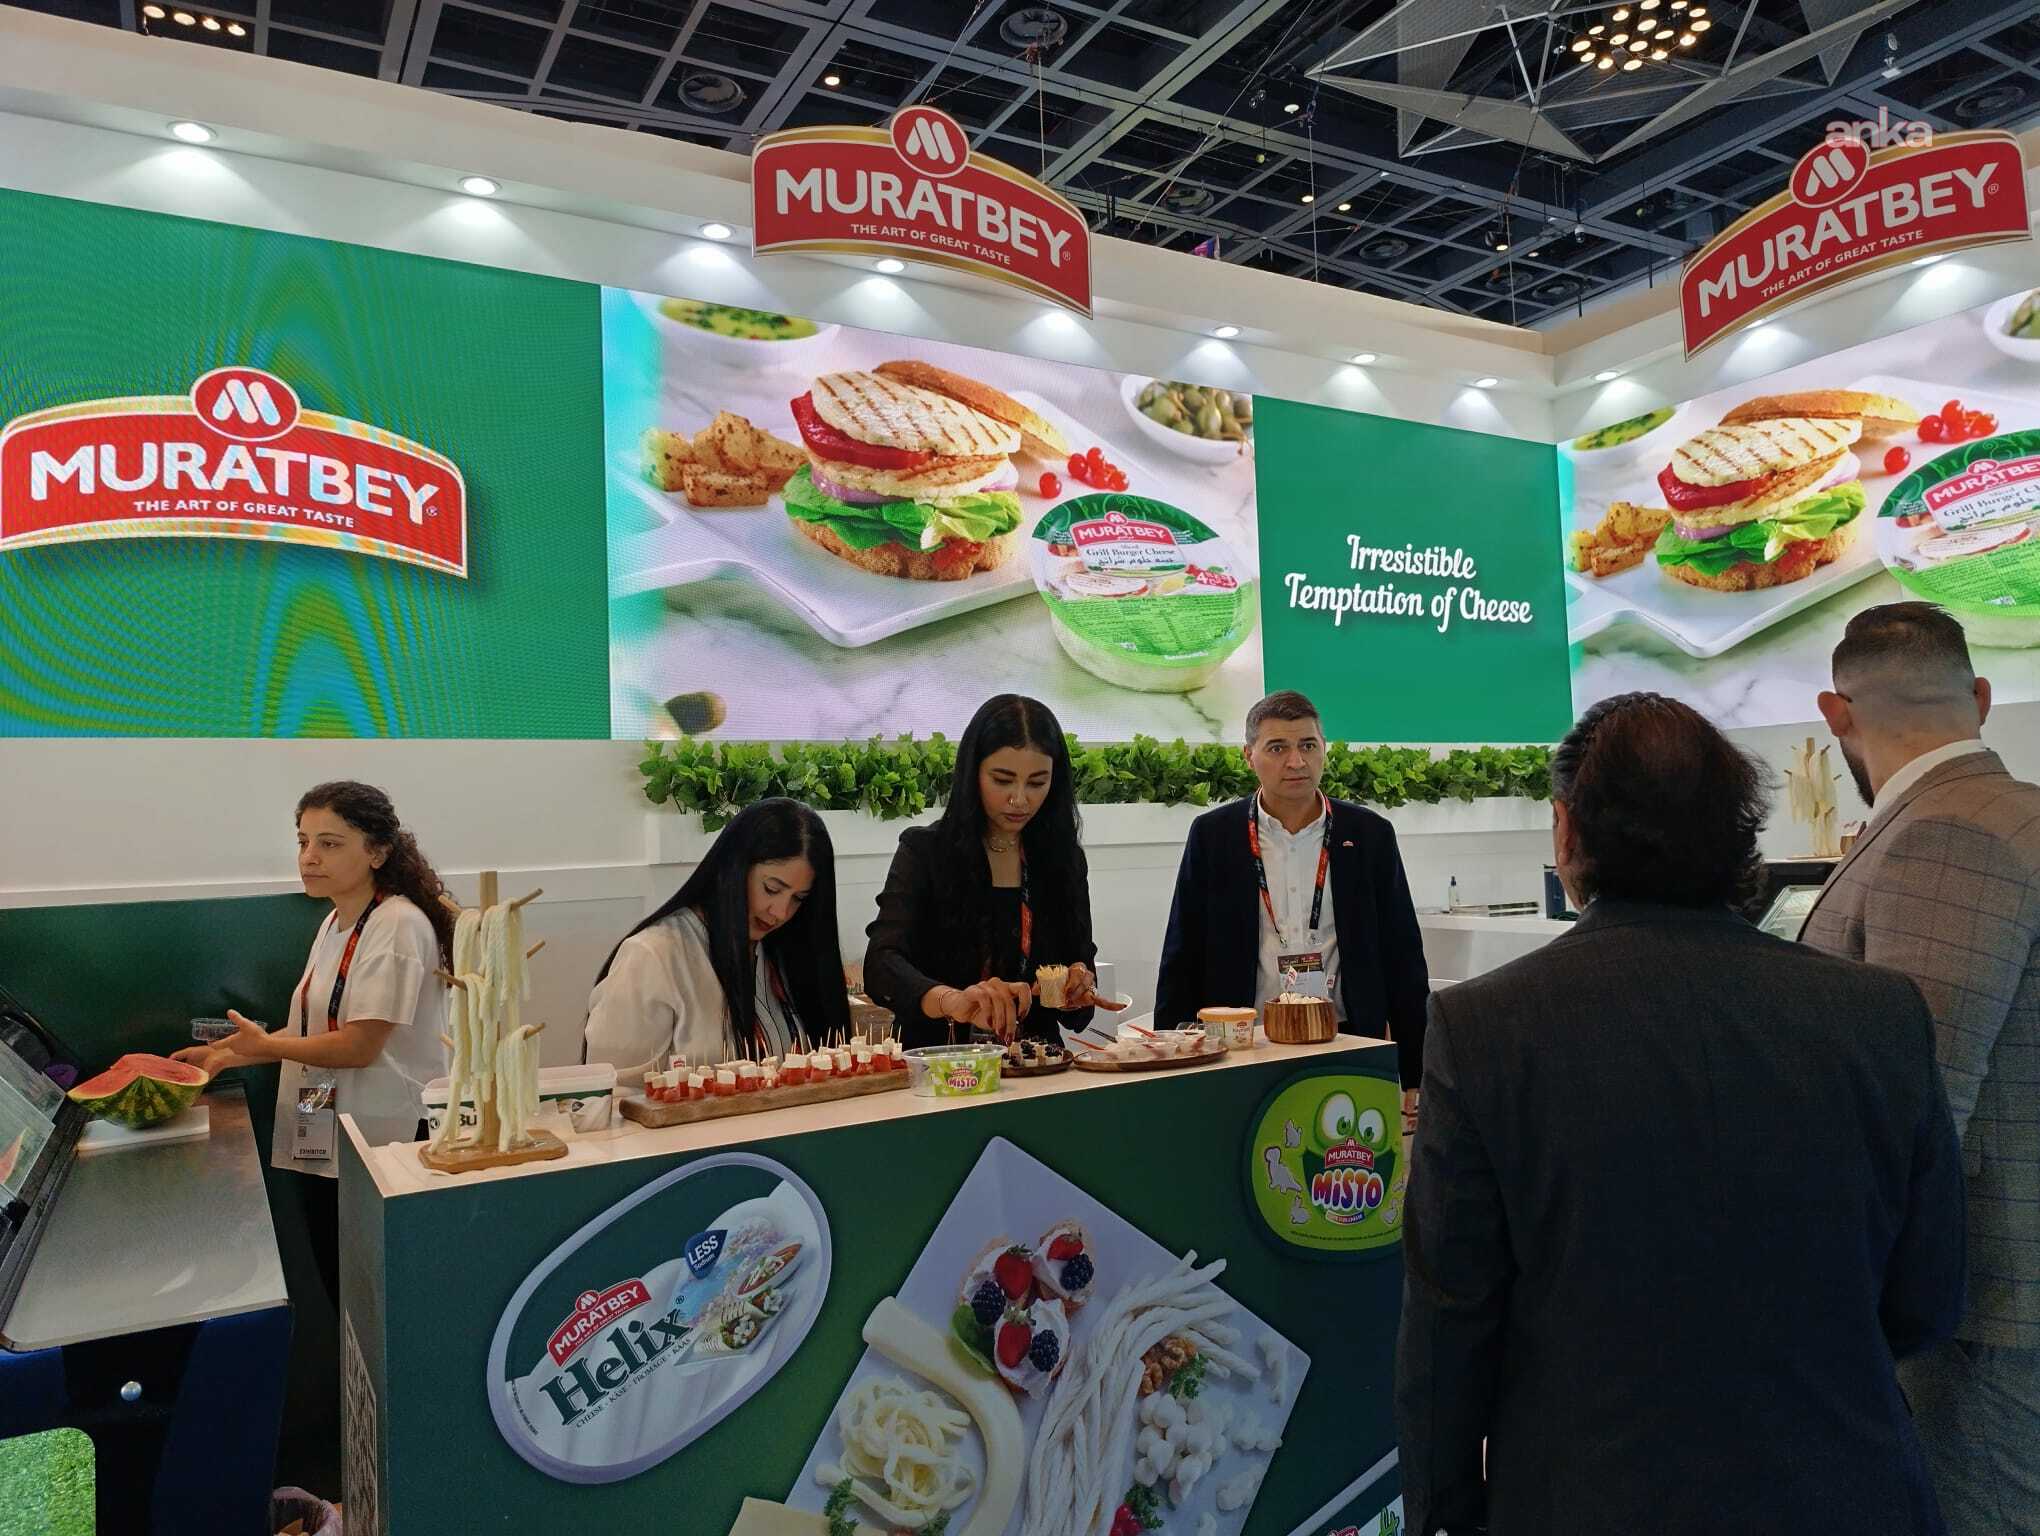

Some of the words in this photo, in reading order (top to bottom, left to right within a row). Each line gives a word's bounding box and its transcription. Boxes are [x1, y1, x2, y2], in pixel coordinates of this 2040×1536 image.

[776, 167, 1072, 268] MURATBEY
[1698, 162, 1999, 318] MURATBEY
[851, 224, 877, 235] THE
[880, 226, 907, 238] ART
[910, 229, 926, 240] OF
[930, 233, 971, 251] GREAT
[973, 245, 1011, 264] TASTE
[1760, 280, 1785, 297] THE
[1787, 267, 1813, 286] ART
[1815, 258, 1832, 272] OF
[1834, 241, 1876, 265] GREAT
[1880, 230, 1924, 248] TASTE
[30, 442, 440, 525] MURATBEY
[1932, 461, 2040, 503] MURATBE
[134, 501, 170, 512] THE
[175, 499, 211, 511] ART
[215, 500, 239, 512] OF
[243, 502, 298, 518] GREAT
[302, 508, 354, 528] TASTE
[1078, 526, 1166, 540] MURATBEY
[1346, 534, 1476, 579] Irresistible
[1284, 573, 1424, 627] Temptation
[1431, 586, 1457, 633] of
[1459, 587, 1533, 624] Cheese
[1328, 1150, 1372, 1161] MURATBEY
[688, 1235, 718, 1264] LESS
[554, 1286, 639, 1355] MURATBEY
[539, 1308, 694, 1426] Helix
